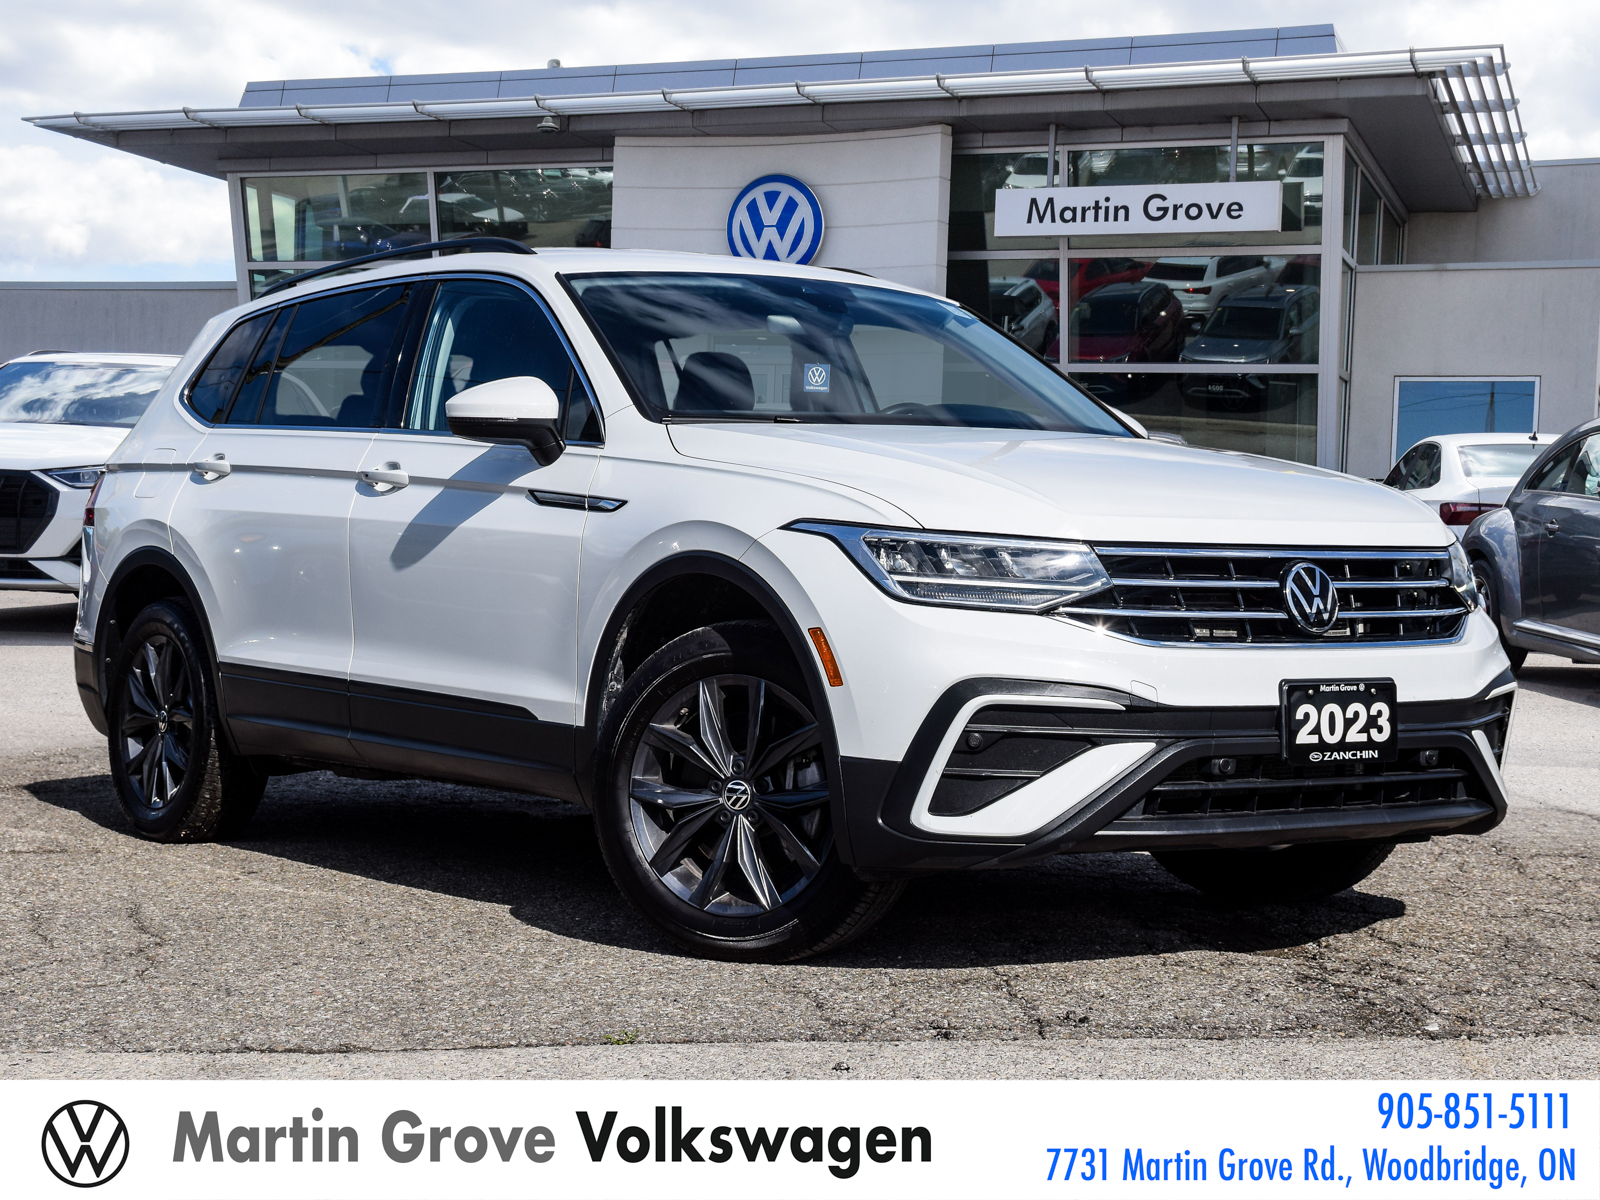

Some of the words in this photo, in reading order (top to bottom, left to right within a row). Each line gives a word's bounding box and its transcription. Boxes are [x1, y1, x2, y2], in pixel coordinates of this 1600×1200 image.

[1026, 196, 1130, 224] Martin
[1142, 193, 1244, 221] Grove
[1319, 684, 1340, 692] Martin
[1340, 683, 1357, 691] Grove
[1295, 701, 1391, 745] 2023
[1323, 749, 1379, 761] ZANCHIN
